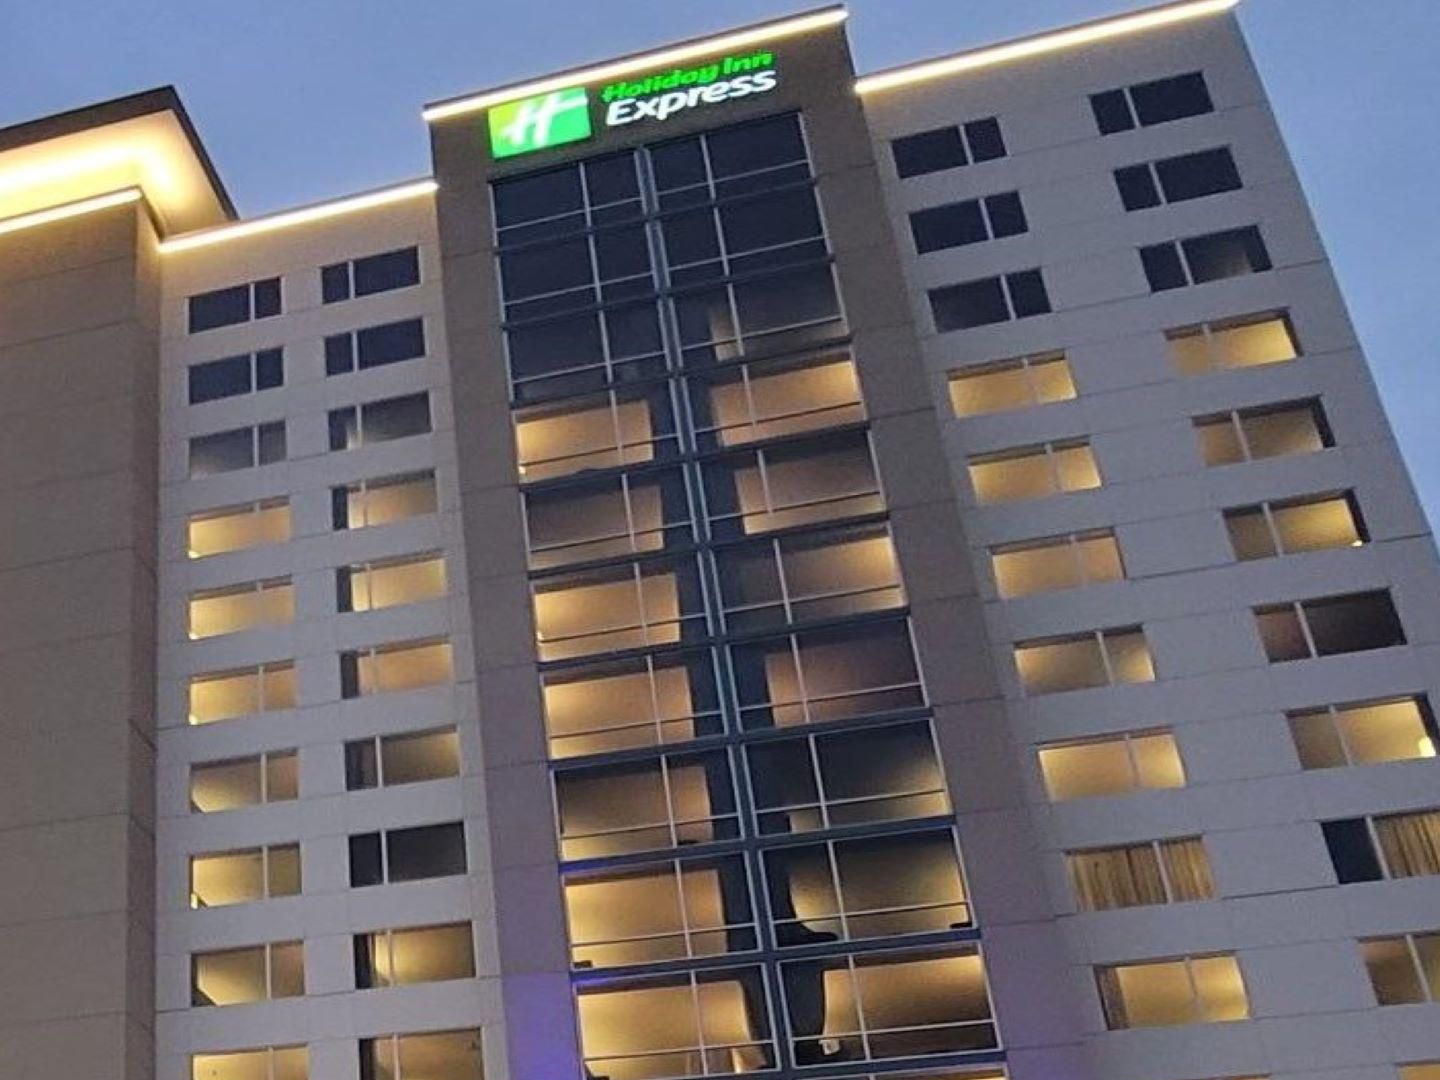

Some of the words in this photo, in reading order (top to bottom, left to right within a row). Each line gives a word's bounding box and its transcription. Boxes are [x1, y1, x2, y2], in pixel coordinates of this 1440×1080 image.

[602, 64, 720, 101] Holiday
[723, 52, 773, 74] Inn
[605, 70, 777, 126] Express
